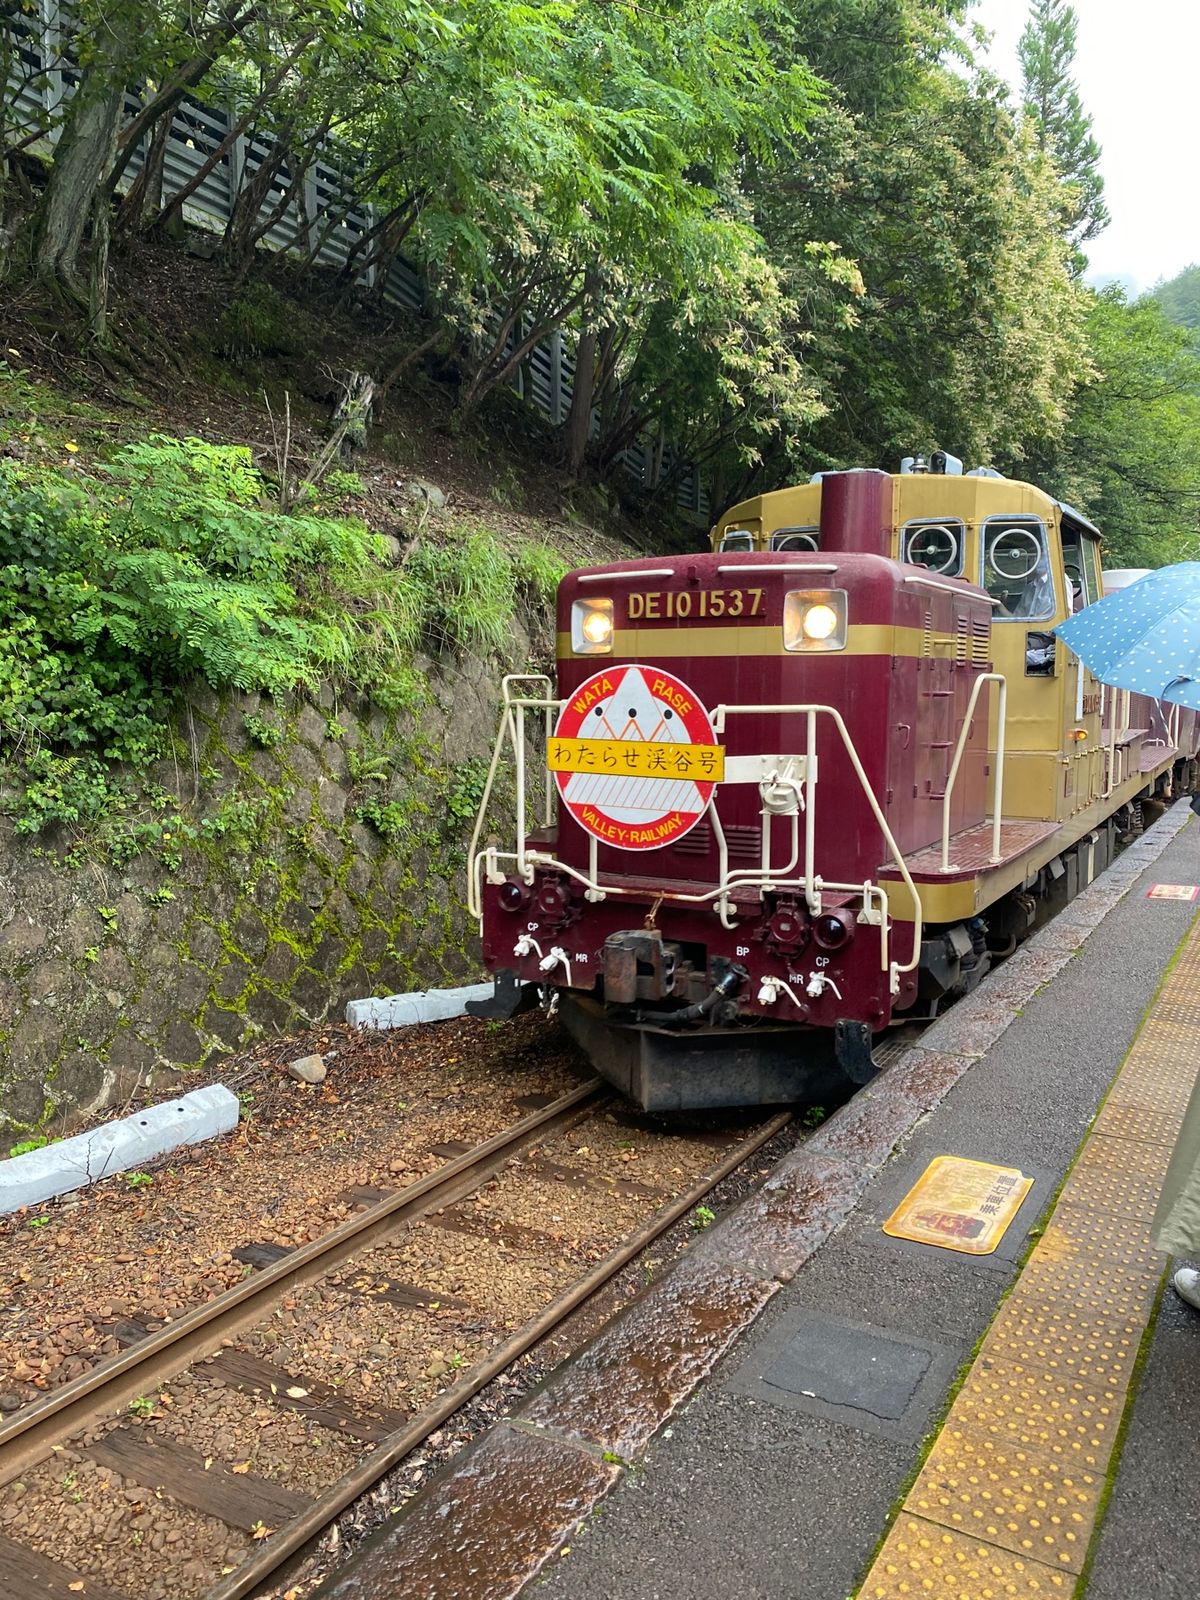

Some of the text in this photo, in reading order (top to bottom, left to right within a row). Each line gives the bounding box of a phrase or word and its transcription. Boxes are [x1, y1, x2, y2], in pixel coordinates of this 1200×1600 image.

[628, 588, 762, 619] DE10 1537
[572, 678, 692, 717] WATA RASE
[554, 743, 718, 775] わたらせ渓谷号
[527, 922, 539, 931] CP
[736, 946, 750, 957] BP
[575, 953, 588, 963] MR
[815, 956, 830, 967] CP
[789, 974, 804, 985] MR
